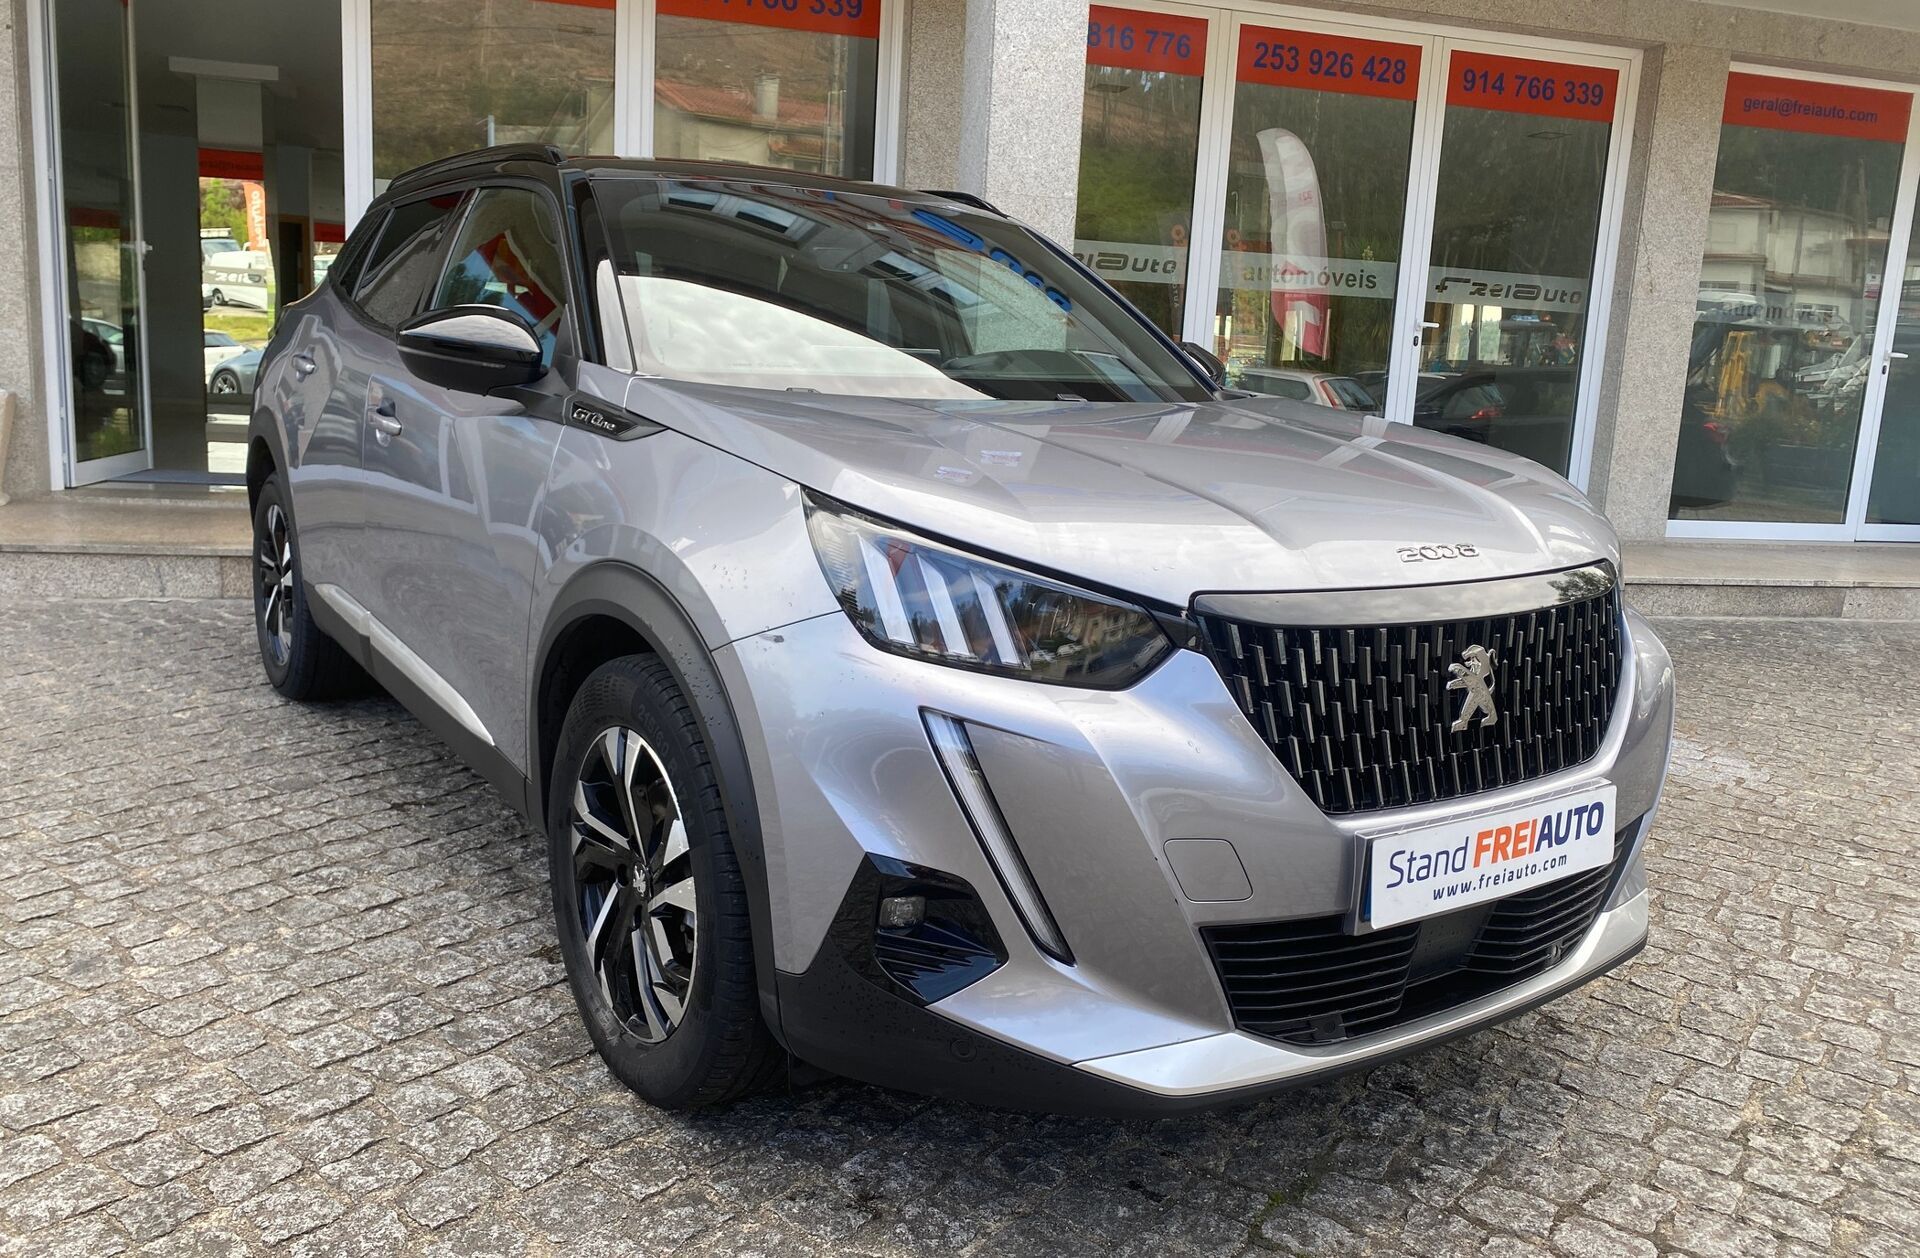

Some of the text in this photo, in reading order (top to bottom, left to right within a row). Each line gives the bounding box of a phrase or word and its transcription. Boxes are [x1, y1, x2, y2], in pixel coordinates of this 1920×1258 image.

[1087, 21, 1191, 59] 816 776
[1253, 42, 1406, 85] 253 926 428
[1463, 68, 1604, 106] 914 766 339
[1743, 97, 1878, 123] geral@freiauto.com
[1242, 264, 1377, 289] automóveis
[1396, 543, 1479, 563] 2008
[1386, 801, 1605, 889] Stand FREIAUTO
[1433, 853, 1568, 901] www.freiauto.com
